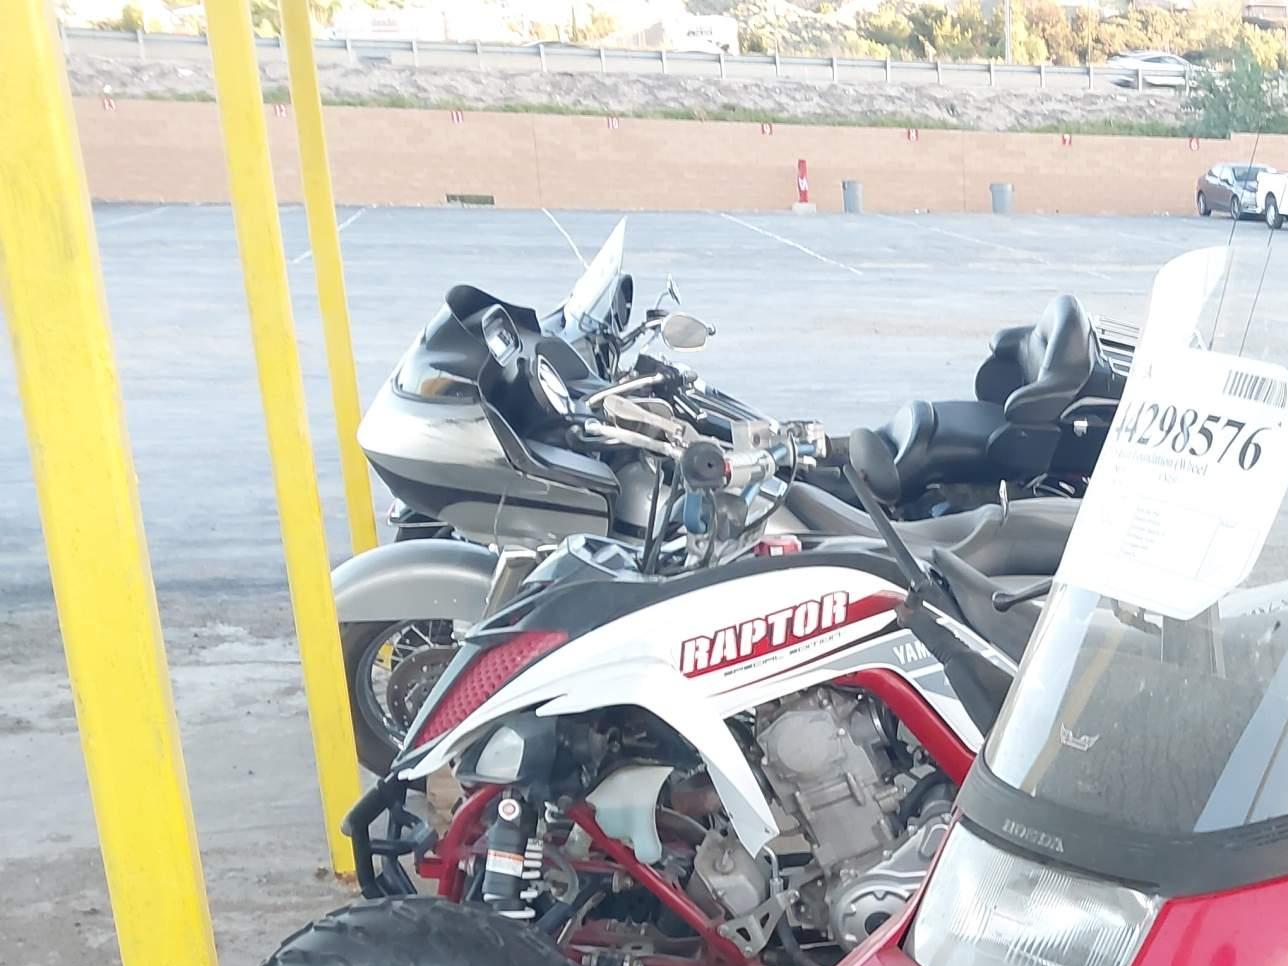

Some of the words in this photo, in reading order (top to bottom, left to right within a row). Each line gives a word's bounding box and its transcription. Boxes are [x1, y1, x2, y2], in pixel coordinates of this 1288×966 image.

[607, 117, 619, 129] 10
[1115, 400, 1272, 471] 44298576
[679, 590, 850, 678] RAPTOR
[1002, 818, 1065, 852] HONDA
